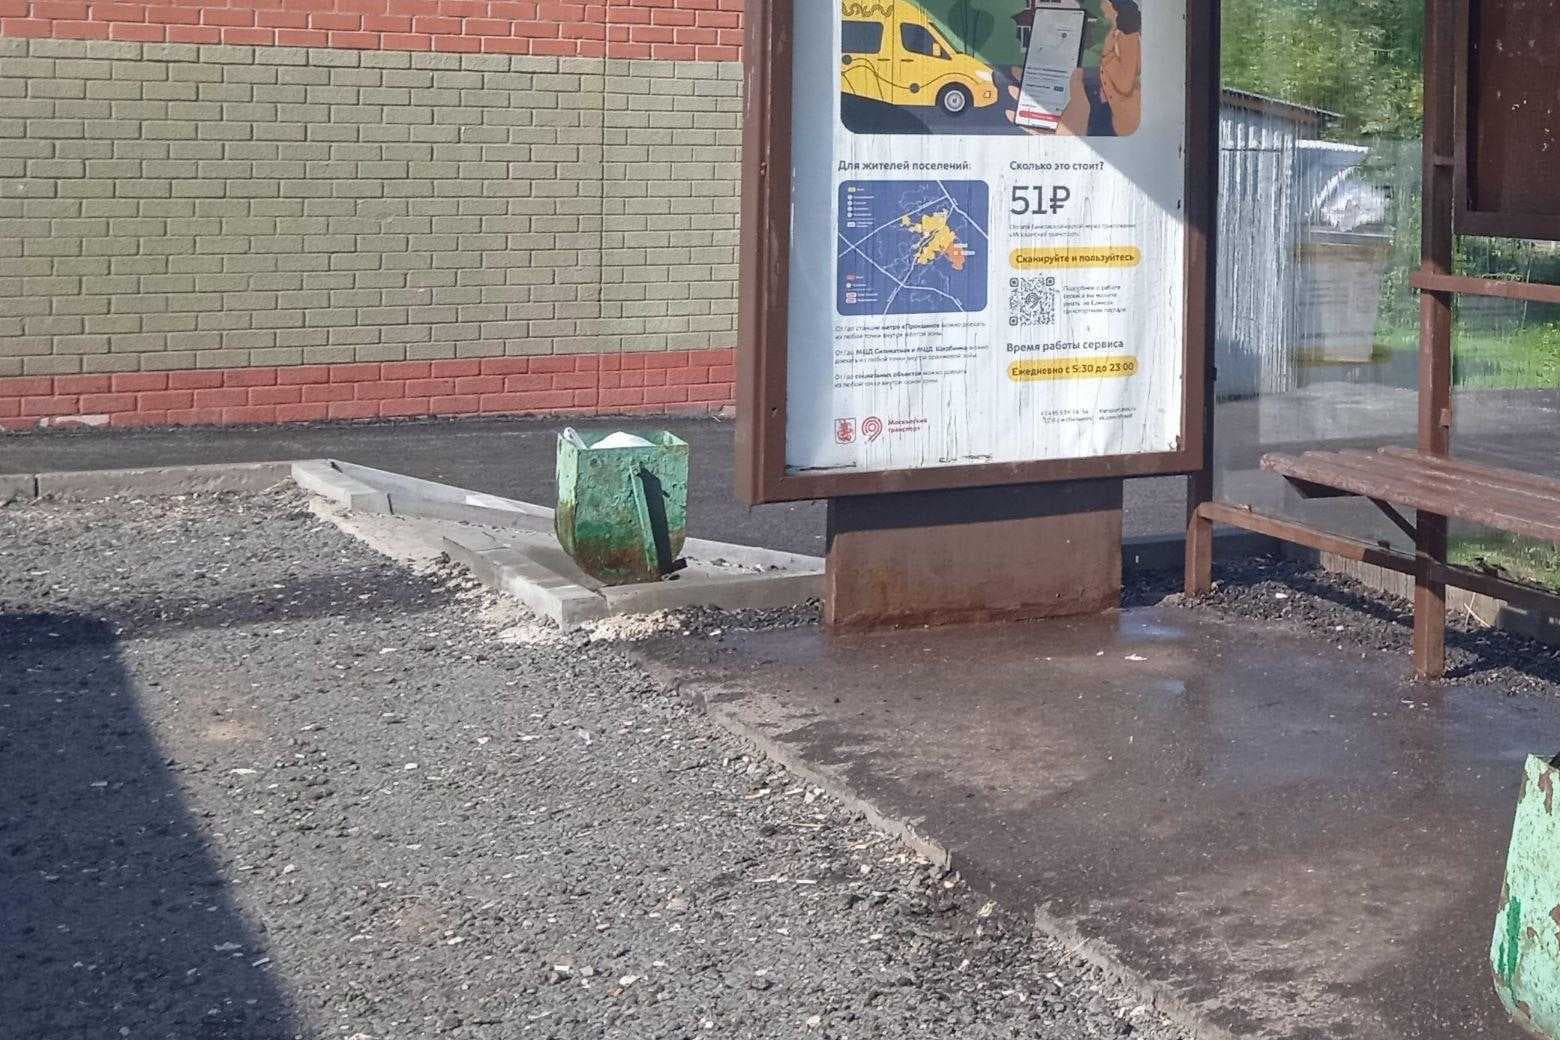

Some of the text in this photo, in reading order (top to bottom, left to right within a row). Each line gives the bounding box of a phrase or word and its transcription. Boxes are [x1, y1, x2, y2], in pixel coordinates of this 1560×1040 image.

[838, 161, 860, 172] Для
[862, 160, 909, 171] жителей
[1009, 161, 1104, 173] Сколько это стоит?
[1016, 254, 1070, 264] Сканируйте
[1079, 254, 1135, 263] пользуйтесь
[1006, 339, 1124, 354] Время работы сервиса
[1012, 367, 1063, 376] Ежедневно
[1095, 365, 1107, 373] до
